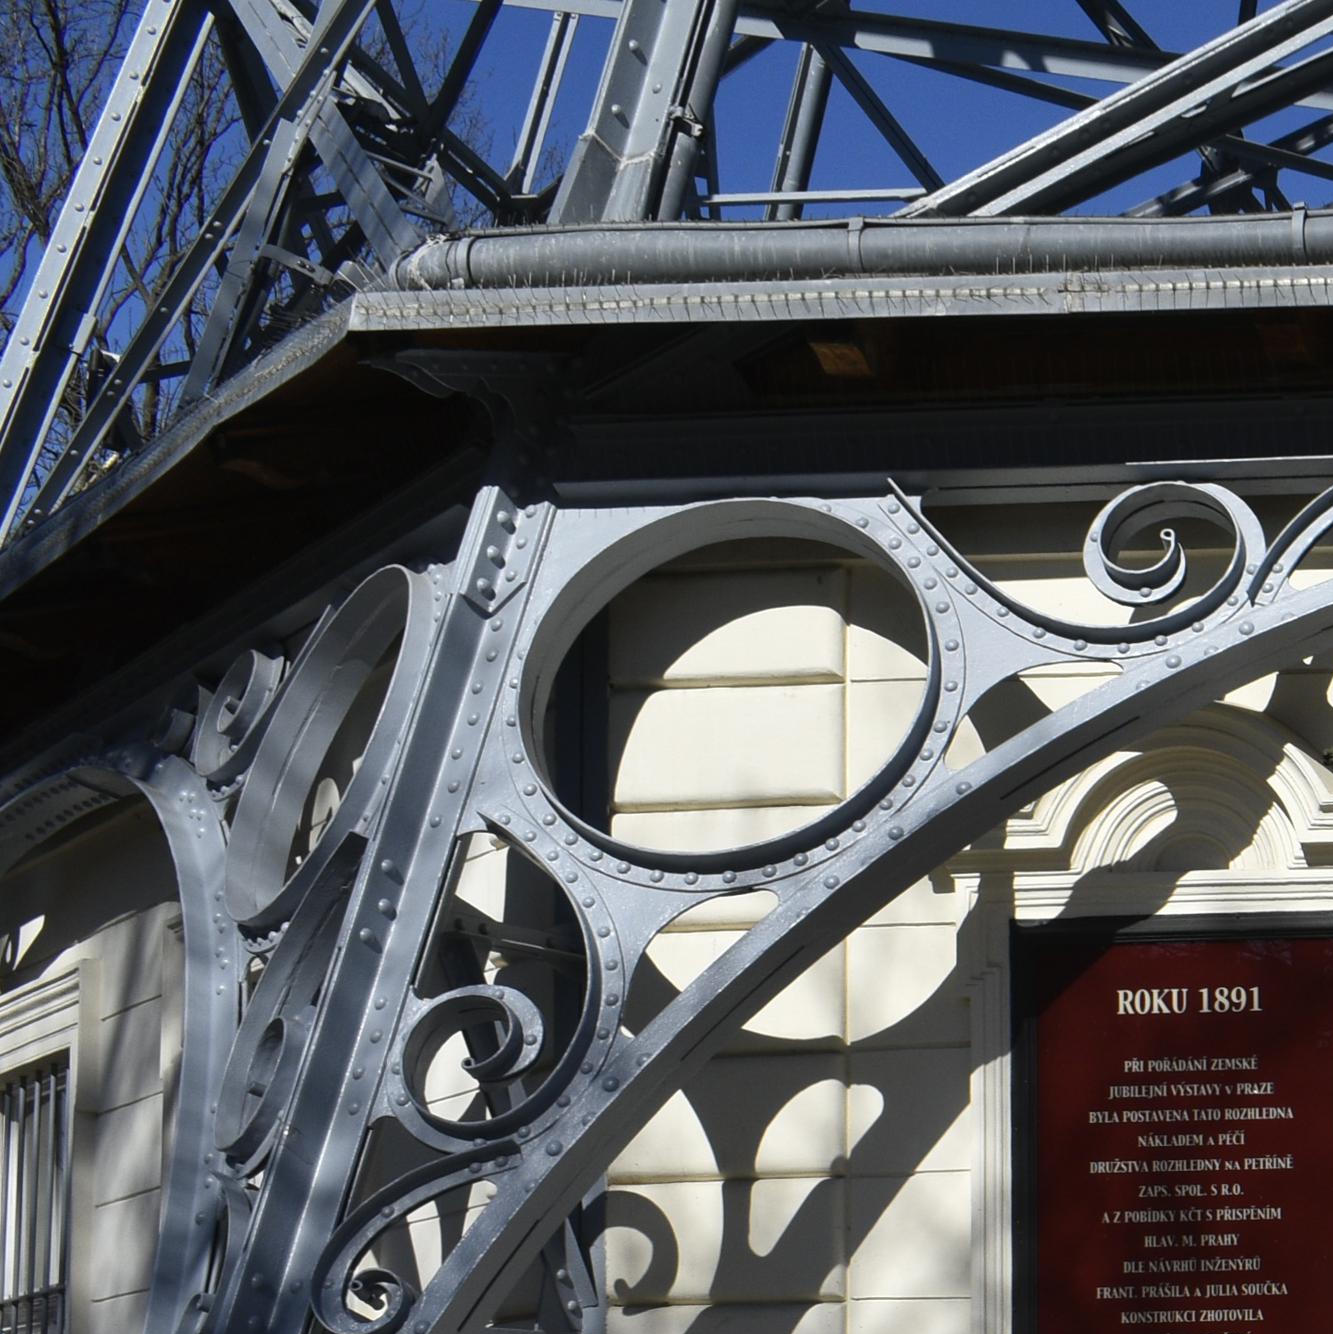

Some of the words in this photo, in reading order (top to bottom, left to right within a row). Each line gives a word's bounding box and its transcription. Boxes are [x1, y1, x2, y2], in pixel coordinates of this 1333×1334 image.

[1117, 989, 1188, 1015] ROKU
[1198, 986, 1263, 1013] 1891
[1124, 1057, 1144, 1072] PŘI
[1148, 1055, 1207, 1072] POŘÁDÁNÍ
[1211, 1054, 1258, 1070] ZEMSKÉ
[1108, 1082, 1167, 1100] JUBILEJNÍ
[1171, 1081, 1222, 1096] VÝSTAVY
[1237, 1082, 1275, 1095] PRAZE
[1089, 1111, 1119, 1123] BYLA
[1123, 1110, 1189, 1123] POSTAVENA
[1192, 1109, 1221, 1120] TATO
[1224, 1107, 1293, 1120] ROZHLEDNA
[1138, 1132, 1204, 1147] NÁKLADEM
[1218, 1130, 1245, 1145] PÉČÍ
[1090, 1158, 1149, 1174] DRUŽSTVA
[1152, 1158, 1221, 1172] ROZHLEDNY
[1244, 1154, 1294, 1170] PETŘÍNĚ
[1139, 1185, 1172, 1197] ZAPS.
[1211, 1184, 1217, 1195] S
[1221, 1184, 1244, 1195] R.O.
[1102, 1212, 1110, 1224] A
[1113, 1212, 1121, 1223] Z
[1124, 1208, 1175, 1223] POBÍDKY
[1179, 1207, 1203, 1222] KČT
[1206, 1209, 1212, 1221] S
[1216, 1205, 1282, 1221] PŘISPĚNÍM
[1144, 1235, 1178, 1248] HLAV.
[1182, 1235, 1196, 1247] M.
[1201, 1234, 1240, 1246] PRAHY
[1123, 1260, 1145, 1273] DLE
[1149, 1256, 1197, 1273] NÁVRHŮ
[1201, 1256, 1261, 1272] INŽENÝRŮ
[1097, 1287, 1137, 1299] FRANT.
[1141, 1283, 1190, 1298] PRÁŠILA
[1205, 1284, 1238, 1298] JULIA
[1241, 1281, 1288, 1296] SOUČKA
[1121, 1310, 1196, 1324] KONSTRUKCI
[1200, 1309, 1264, 1322] ZHOTOVILA
